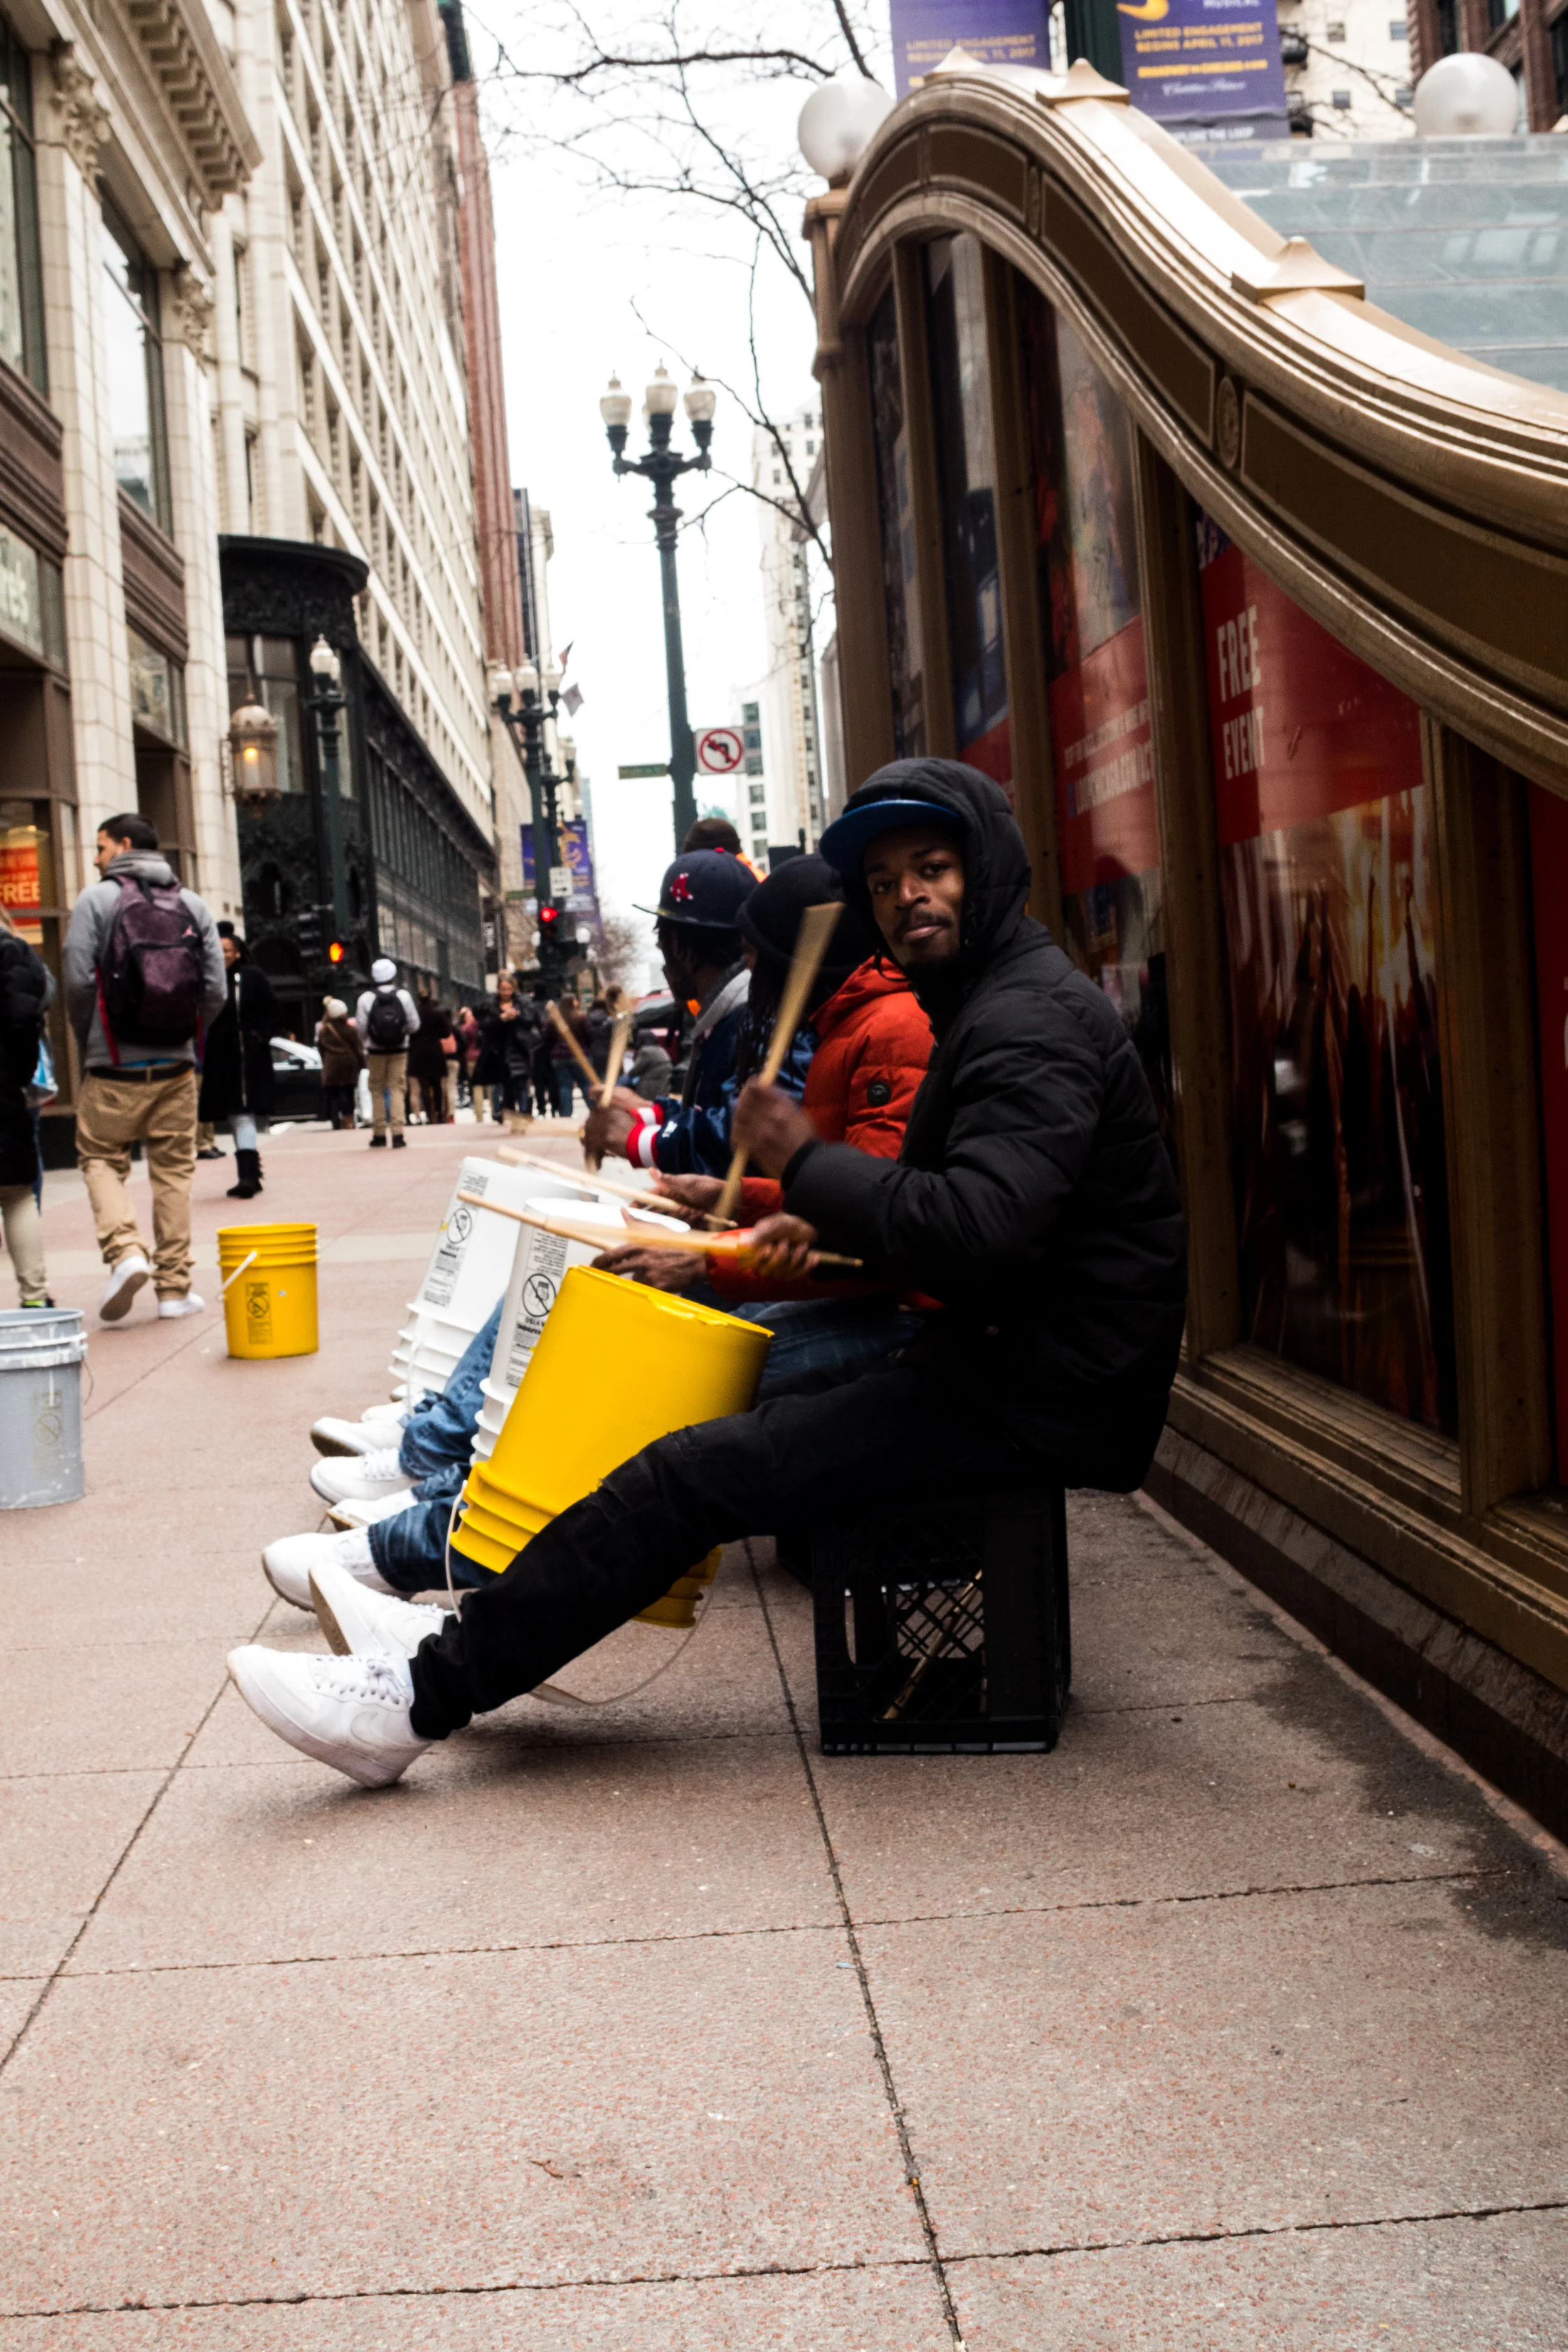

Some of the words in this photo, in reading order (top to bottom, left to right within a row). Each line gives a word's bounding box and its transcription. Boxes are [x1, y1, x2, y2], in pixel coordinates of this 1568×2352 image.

[1134, 27, 1182, 40] LIMITED
[1183, 21, 1263, 38] ENGAGEMENT
[1135, 40, 1180, 53] BEGINS
[1182, 37, 1217, 50] APRIL
[1237, 33, 1264, 47] 2017
[1217, 605, 1261, 703] FREE
[1223, 705, 1265, 780] EVENT
